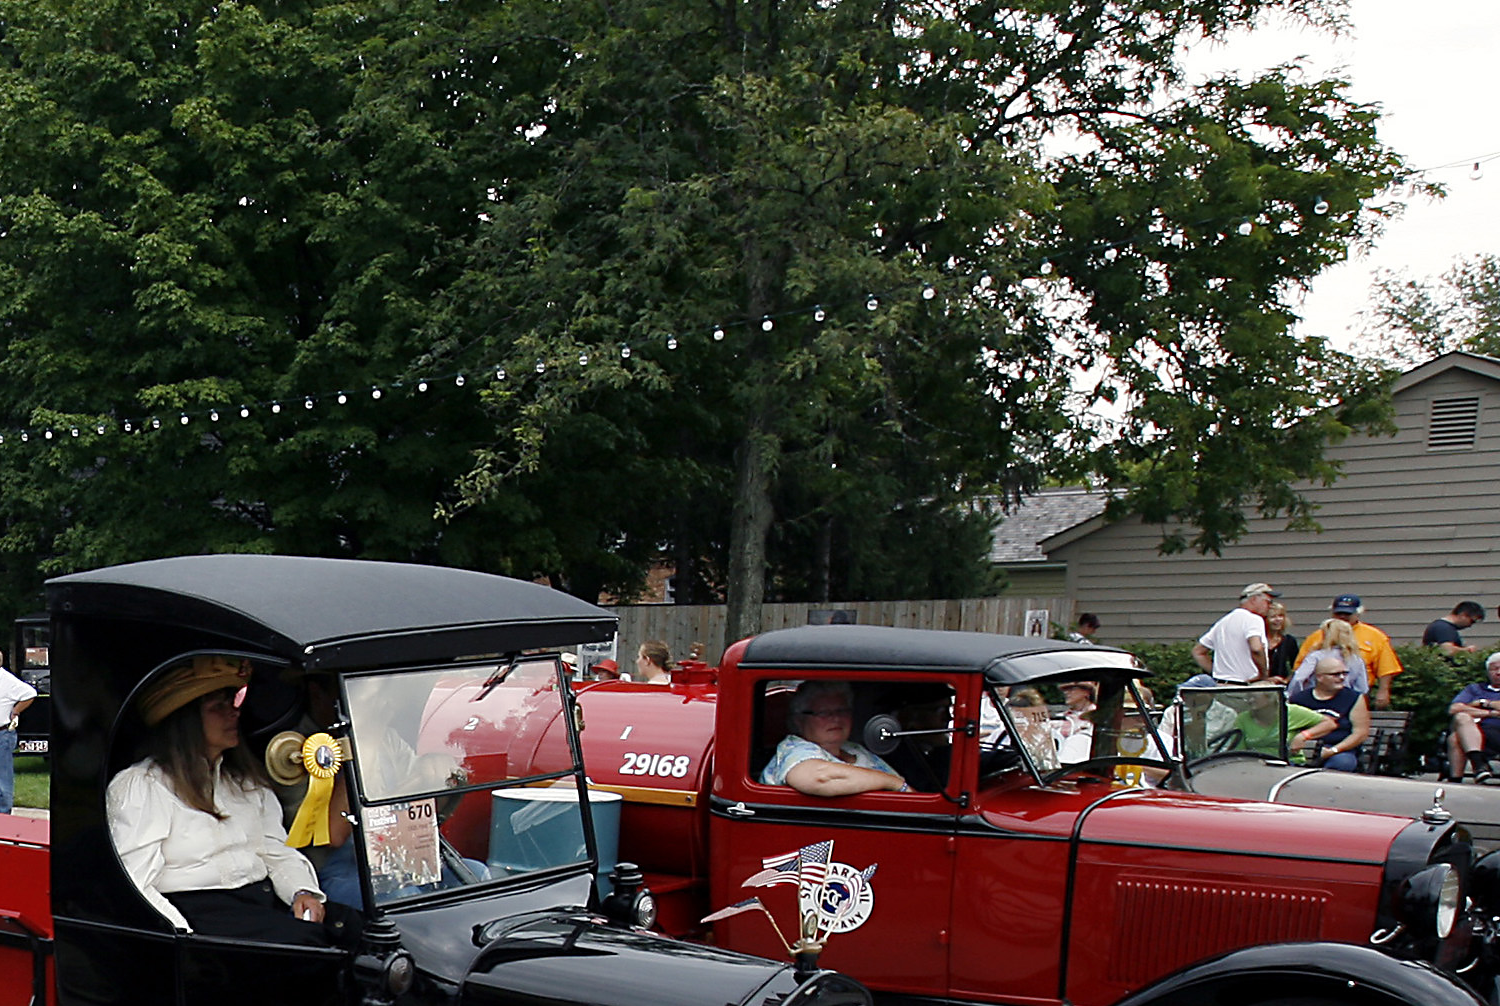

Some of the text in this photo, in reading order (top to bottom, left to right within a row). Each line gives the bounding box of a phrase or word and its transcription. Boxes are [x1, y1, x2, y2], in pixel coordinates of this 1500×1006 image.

[464, 717, 480, 731] 2
[619, 752, 691, 778] 29168
[408, 803, 432, 820] 670
